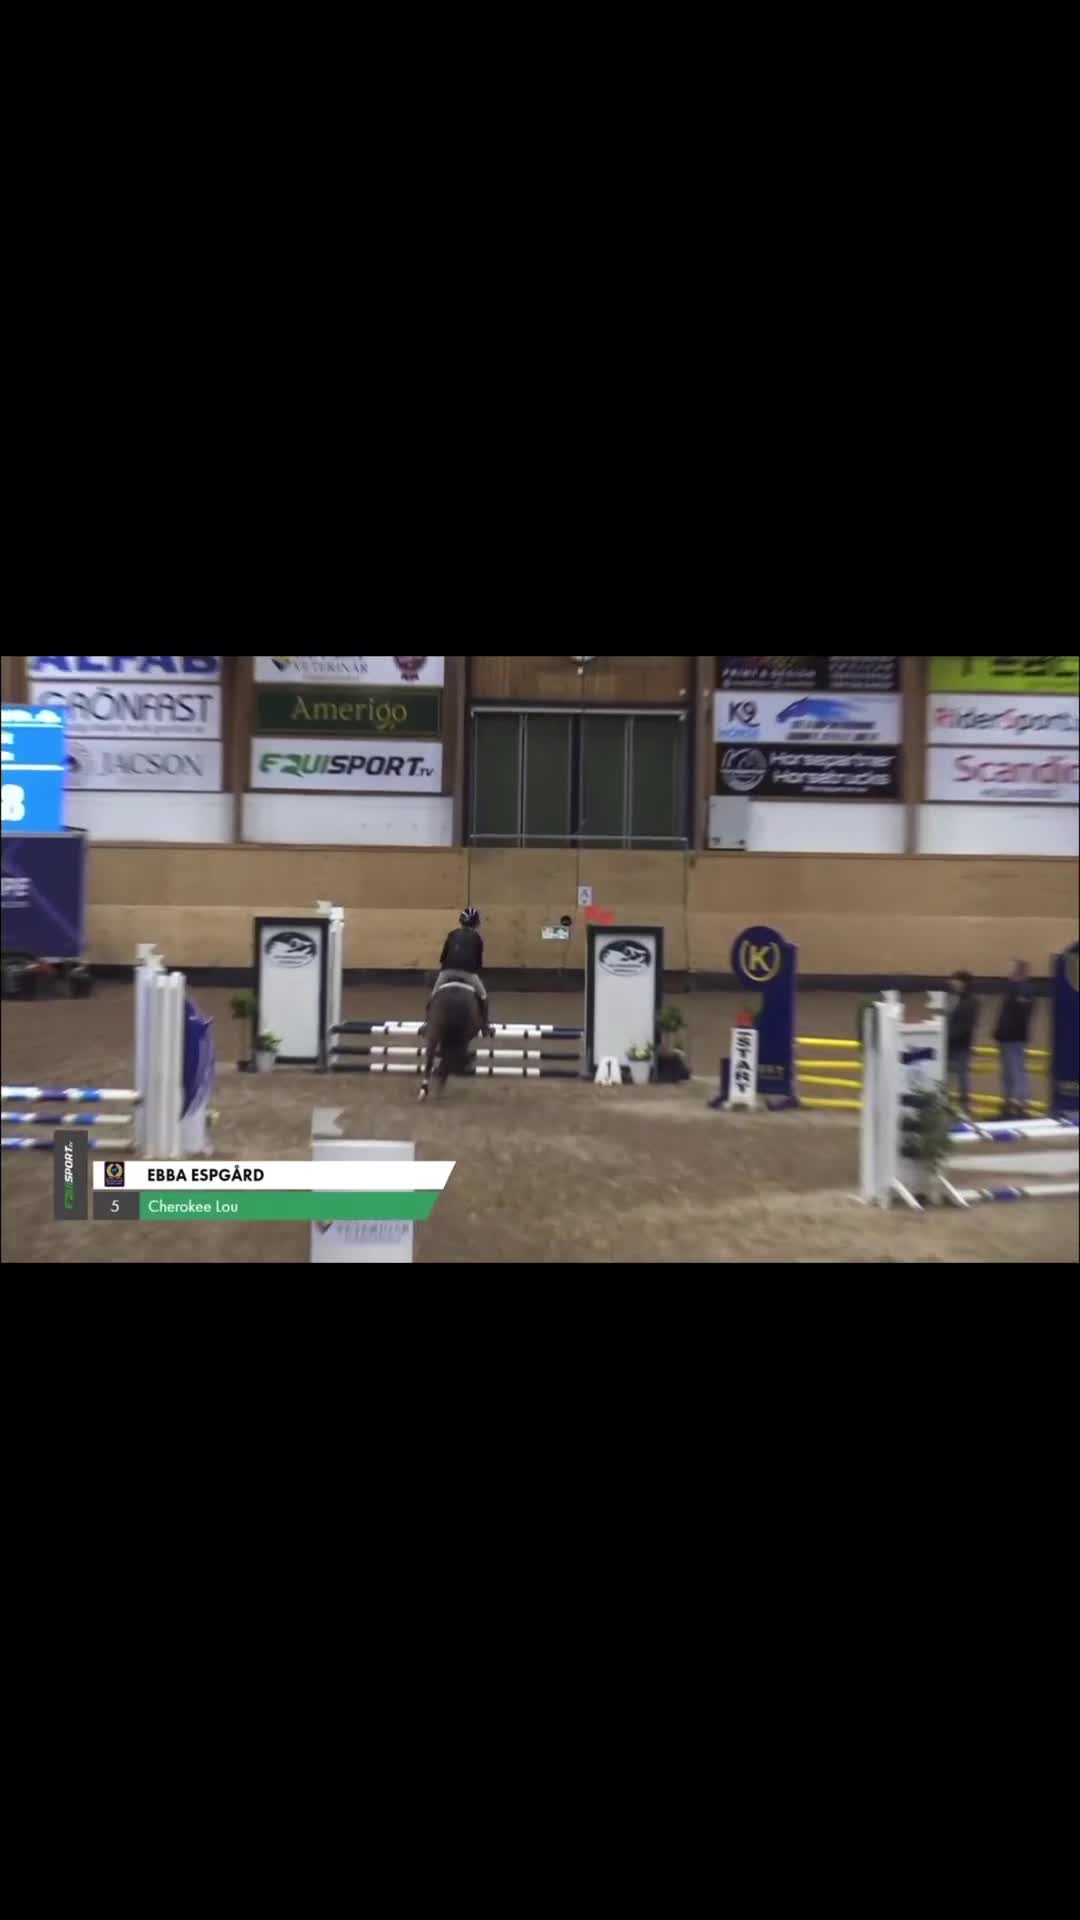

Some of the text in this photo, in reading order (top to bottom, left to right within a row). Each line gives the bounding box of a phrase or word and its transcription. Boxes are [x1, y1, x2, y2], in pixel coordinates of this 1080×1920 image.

[292, 696, 408, 731] Amerigo
[97, 753, 203, 776] JACSON
[736, 1038, 752, 1093] START
